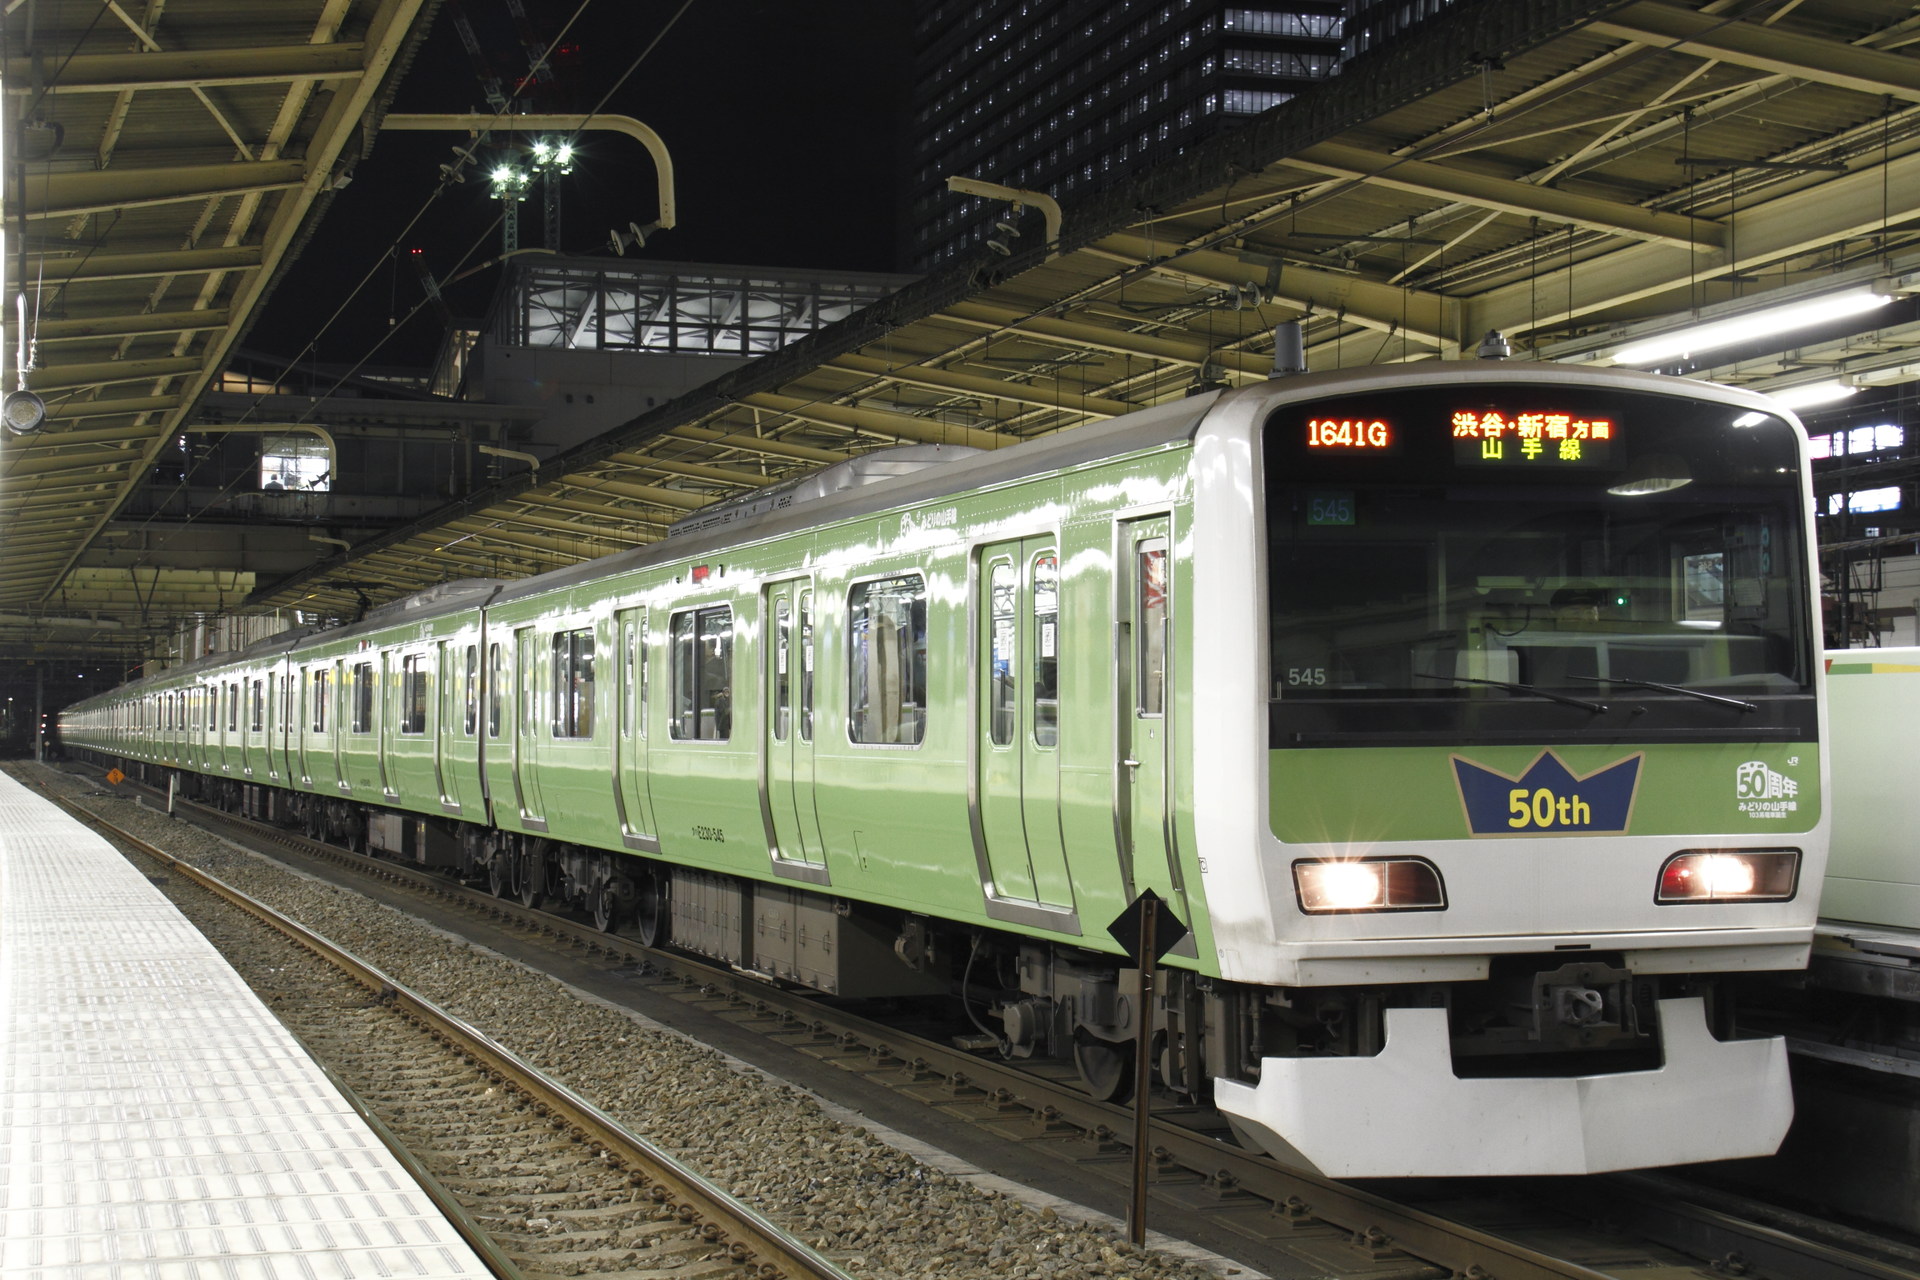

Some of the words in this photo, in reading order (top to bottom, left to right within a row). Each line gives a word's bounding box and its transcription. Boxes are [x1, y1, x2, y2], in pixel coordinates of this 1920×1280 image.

[1308, 420, 1387, 447] 1641G
[1452, 412, 1609, 439] 渋谷・新宿方面
[1313, 499, 1350, 522] 545
[1289, 668, 1326, 686] 545
[1508, 787, 1591, 828] 50th
